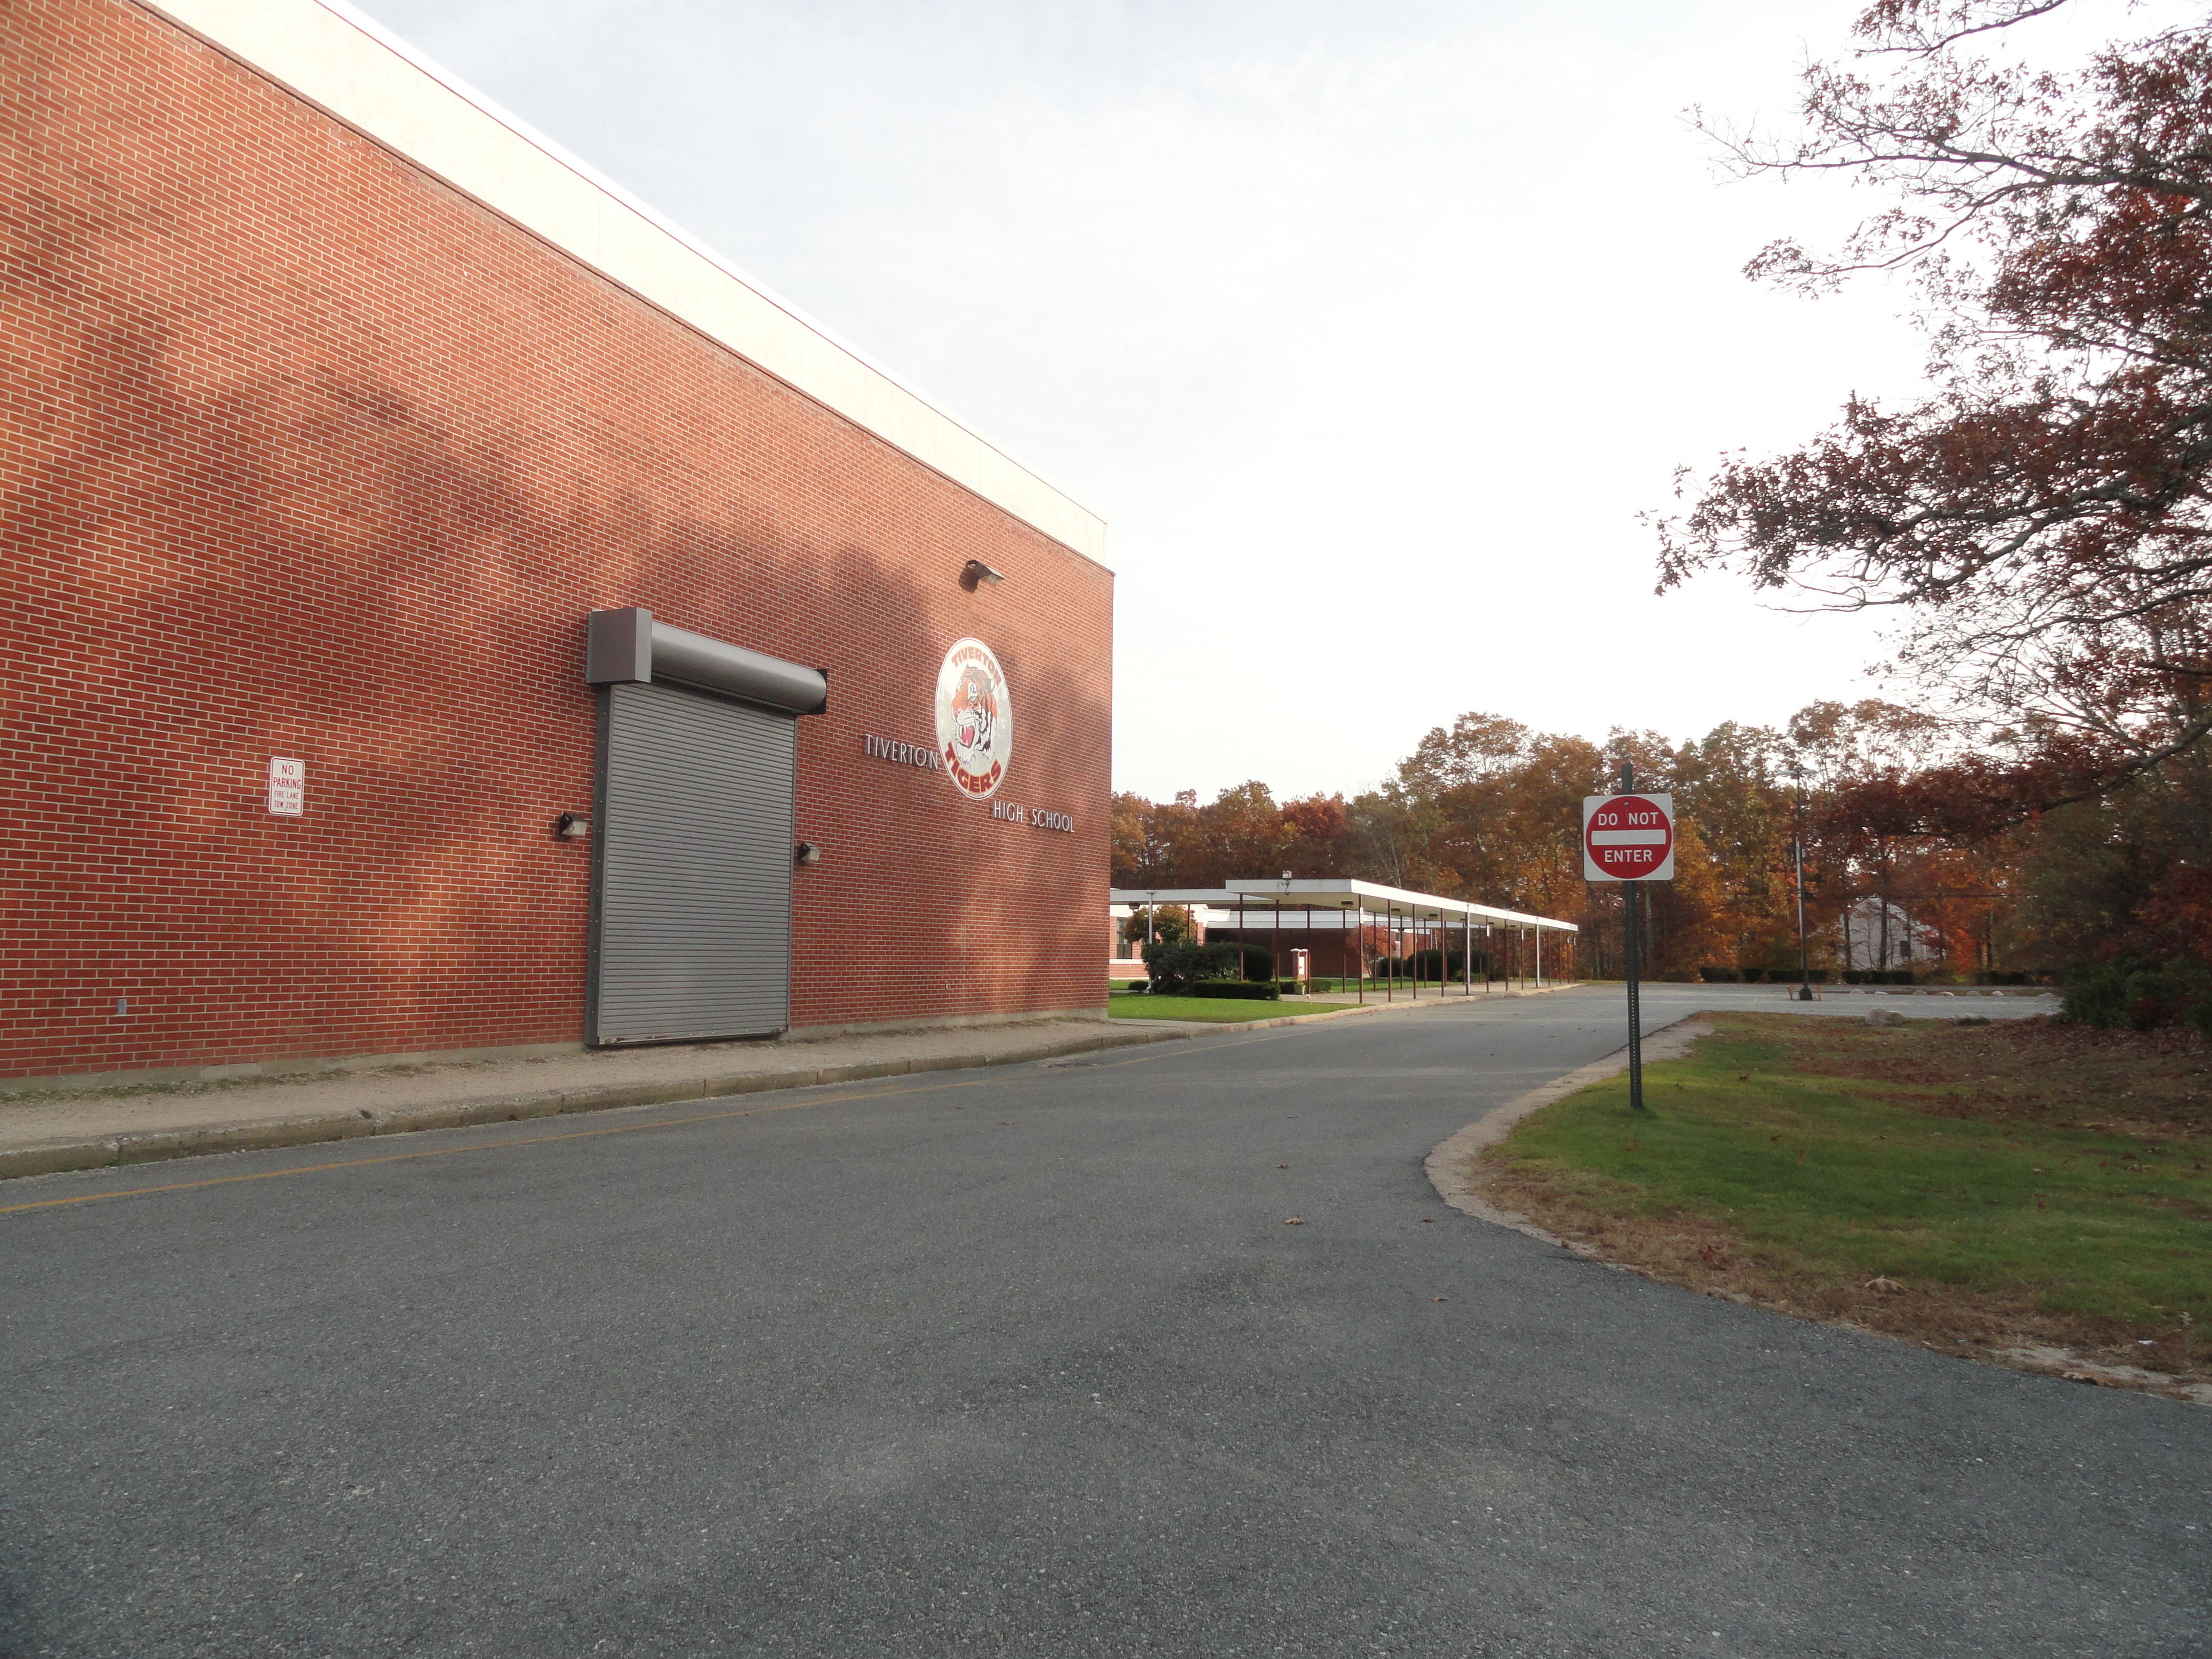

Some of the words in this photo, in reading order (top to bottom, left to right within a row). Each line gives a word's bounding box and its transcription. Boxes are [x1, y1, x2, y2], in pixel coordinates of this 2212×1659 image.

[951, 646, 1002, 687] TIVERTON
[865, 734, 938, 770] TIVERTON
[282, 764, 294, 775] NO
[945, 741, 1002, 793] TIGERS
[273, 777, 301, 789] PARKING
[994, 800, 1023, 823] HIGH
[1032, 809, 1075, 833] SCHOOL
[1598, 813, 1618, 825] DO
[1628, 812, 1658, 825] NOT
[1604, 849, 1653, 862] ENTER
